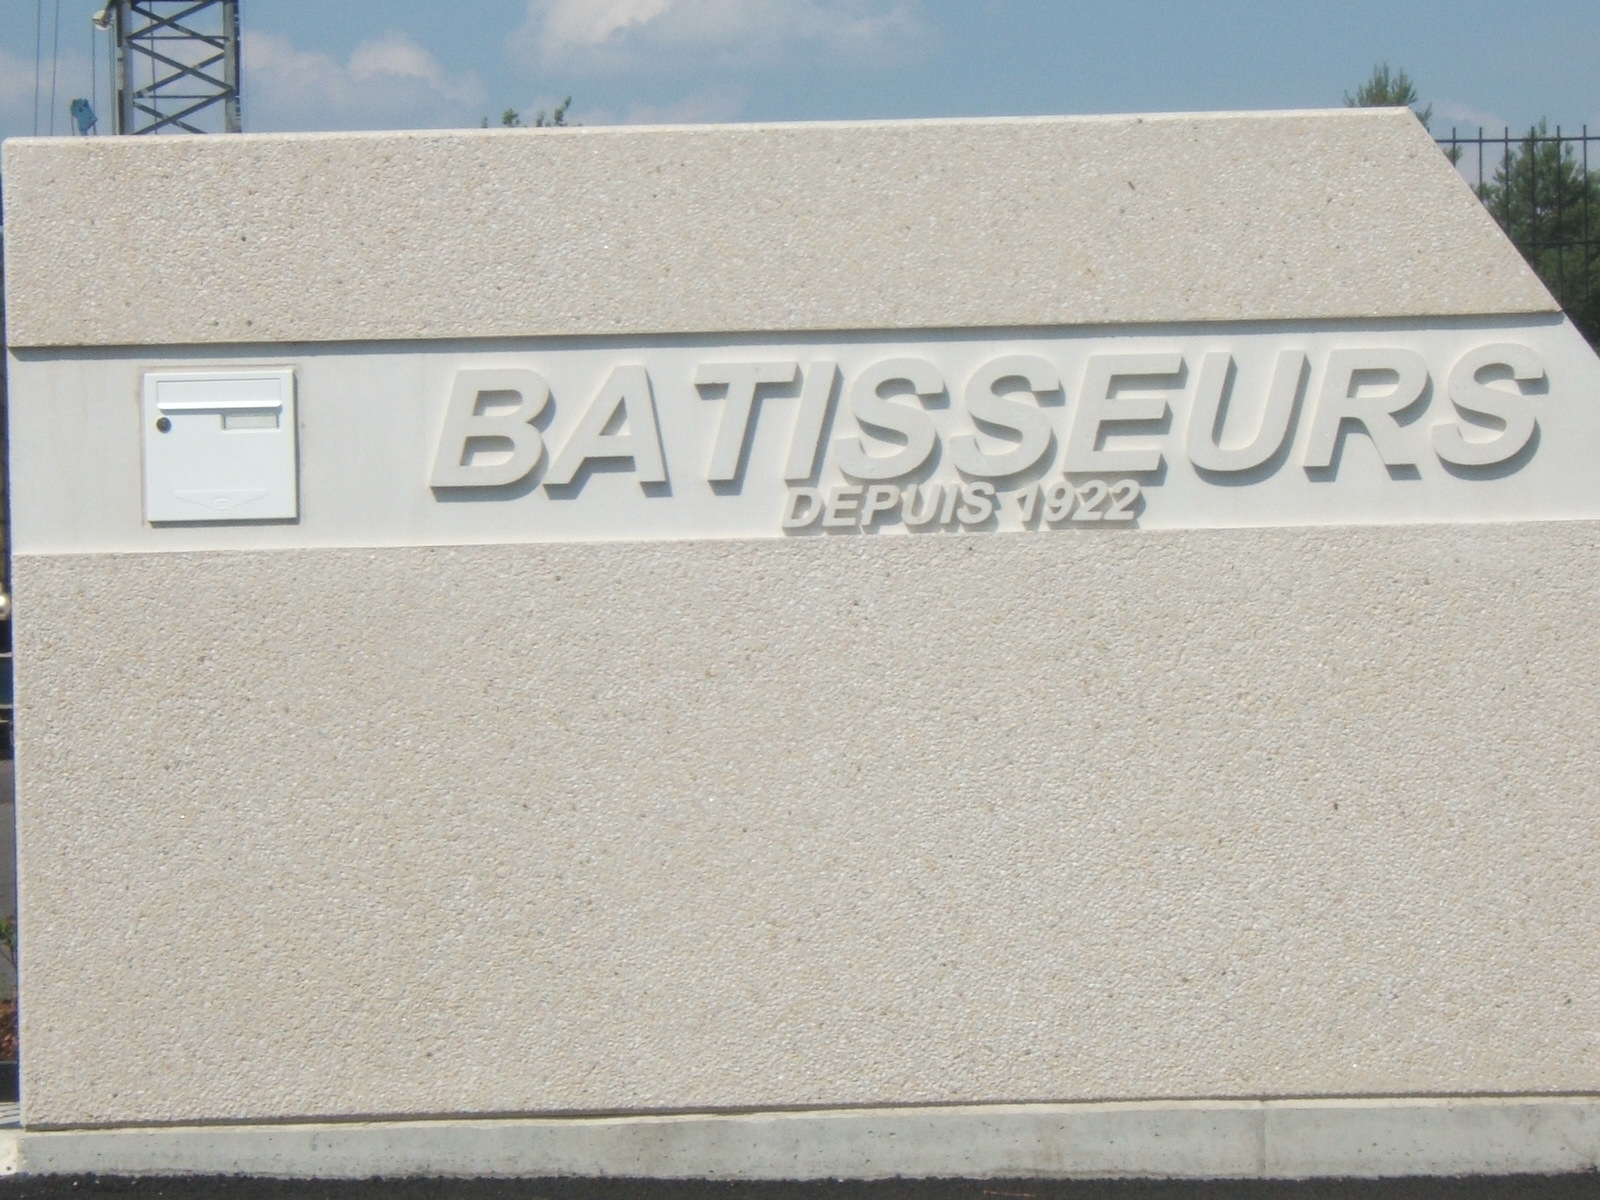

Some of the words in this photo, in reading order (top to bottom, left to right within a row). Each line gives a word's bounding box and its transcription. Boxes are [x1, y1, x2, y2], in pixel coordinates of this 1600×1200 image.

[429, 342, 1545, 488] BATISSEURS
[782, 481, 996, 528] DEPUIS
[1016, 479, 1141, 523] 1922
